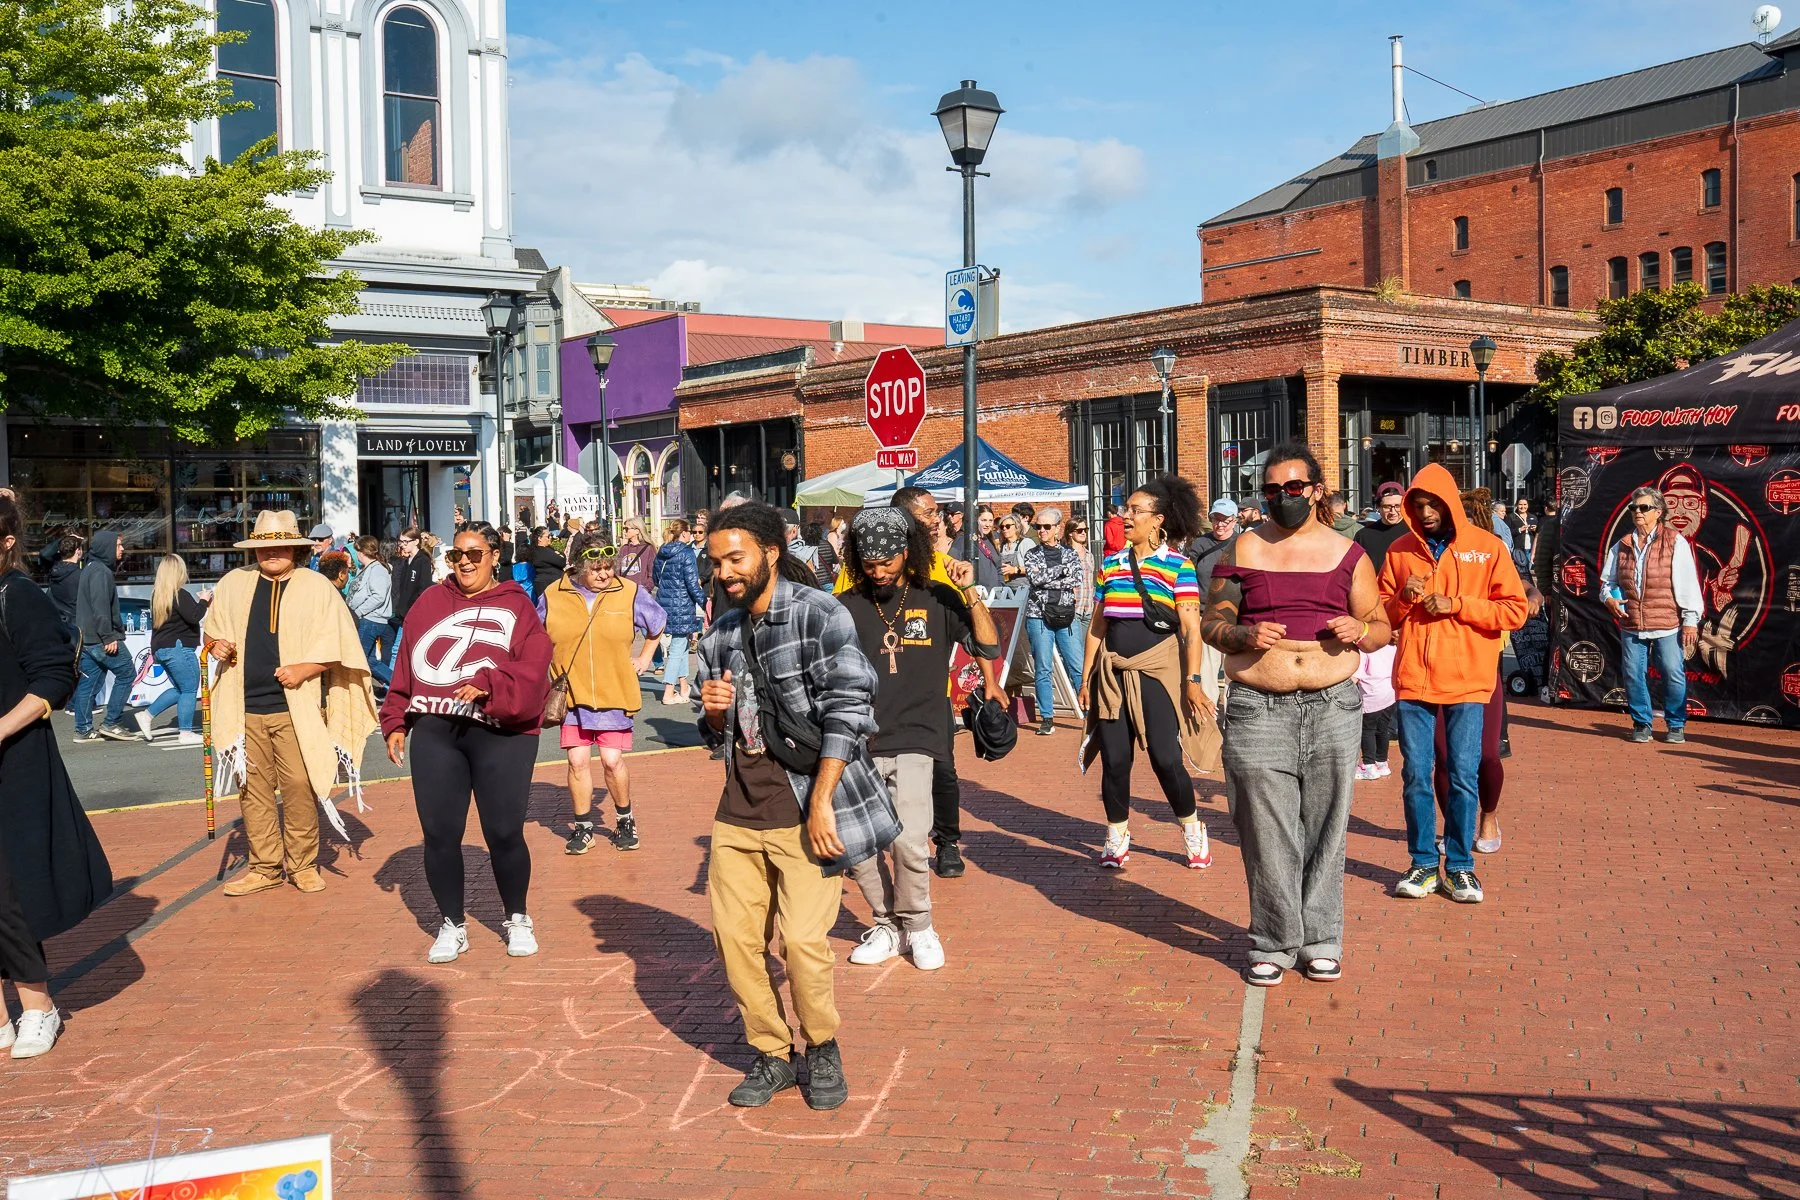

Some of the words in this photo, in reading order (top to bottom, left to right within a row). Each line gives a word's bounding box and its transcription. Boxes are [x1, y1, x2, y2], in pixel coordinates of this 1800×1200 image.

[949, 271, 976, 286] LEAVING
[952, 313, 971, 324] HAZARD
[955, 322, 968, 332] ZONE
[1402, 346, 1470, 368] TIMBER
[869, 376, 922, 419] STOP
[1620, 408, 1662, 428] FOOD
[1662, 407, 1702, 426] WITH
[1702, 404, 1738, 427] HOY
[1776, 403, 1800, 423] FO
[367, 439, 403, 451] LAND
[405, 438, 417, 454] of
[418, 439, 467, 452] LOVELY
[879, 453, 895, 466] ALL
[897, 452, 914, 465] WAY
[976, 468, 1030, 482] Familia
[41, 510, 149, 528] housewares
[197, 506, 245, 525] local
